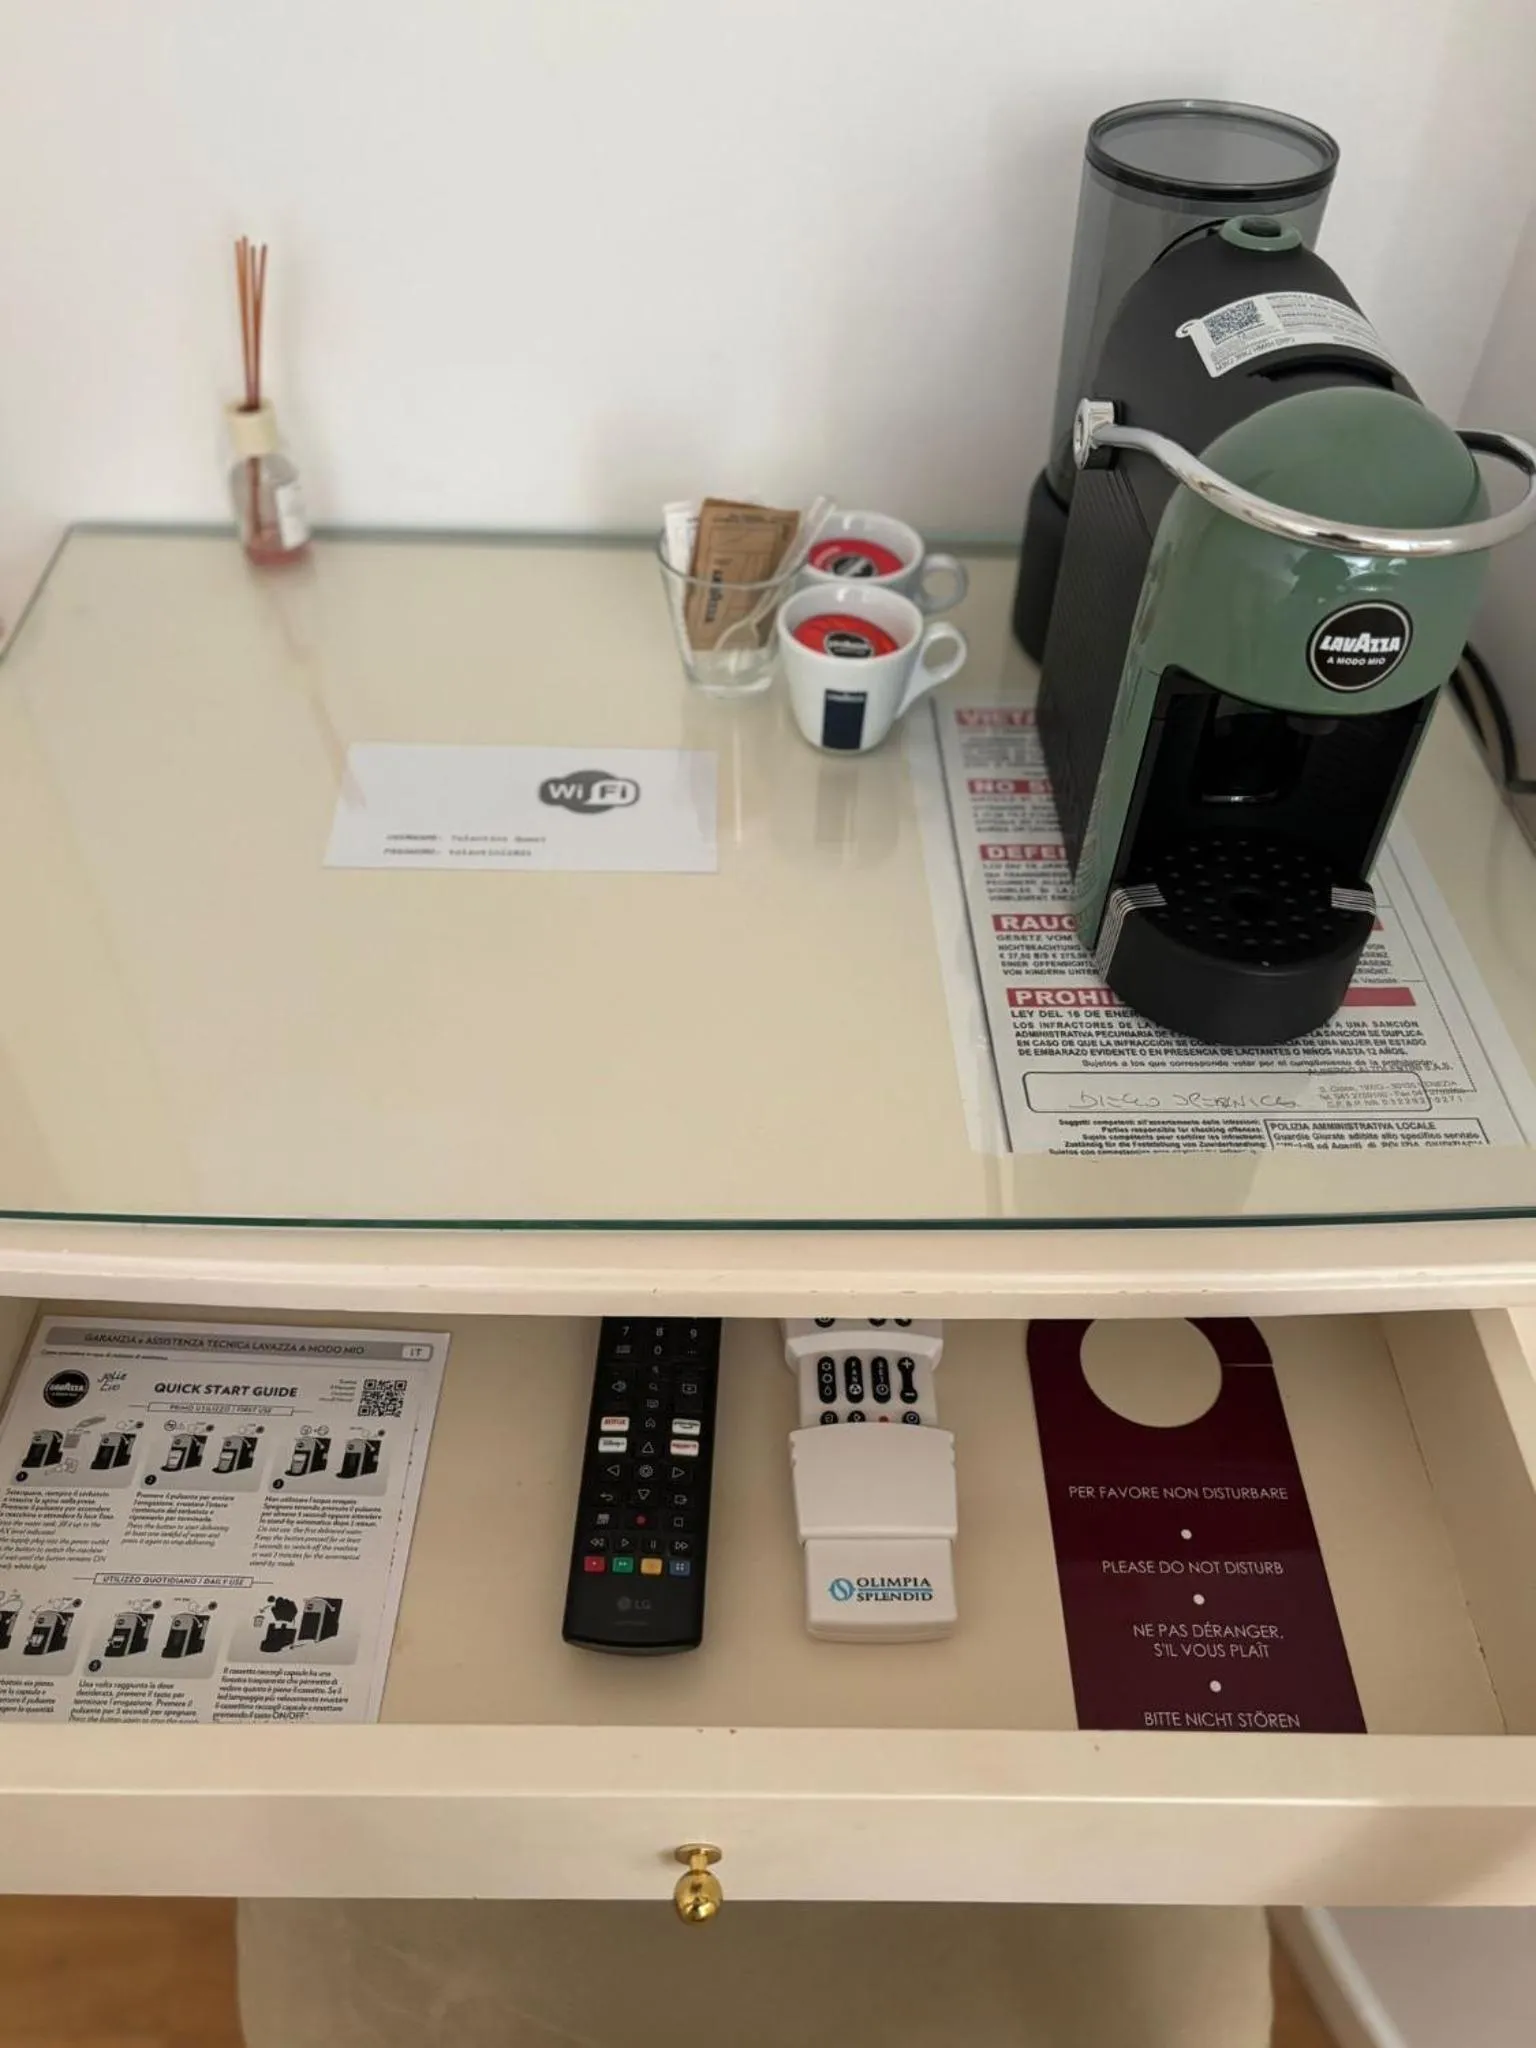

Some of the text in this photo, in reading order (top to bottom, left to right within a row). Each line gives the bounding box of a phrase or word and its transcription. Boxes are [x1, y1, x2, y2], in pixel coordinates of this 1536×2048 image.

[1319, 632, 1400, 653] LAVAZZA
[1326, 657, 1386, 666] A MODO MIO
[1010, 1009, 1034, 1018] LEY
[1039, 1009, 1063, 1018] DEL
[1084, 1009, 1101, 1018] DE
[1013, 1021, 1034, 1029] LOS
[1039, 1021, 1114, 1029] INFRACTORES
[1118, 1021, 1133, 1029] DE
[1015, 1030, 1094, 1038] ADMINISTRATIVA
[1017, 1039, 1030, 1047] EN
[1032, 1039, 1059, 1047] CASO
[1062, 1039, 1075, 1047] DE
[1078, 1039, 1098, 1047] QUE
[1018, 1048, 1032, 1056] DE
[1034, 1048, 1088, 1056] EMBARAZO
[1090, 1048, 1137, 1056] EVIDENTE
[1270, 1121, 1437, 1131] POLIZIA AMMINISTRATIVA LOCALE
[622, 1326, 698, 1339] 7 8 9
[84, 1333, 137, 1344] GARANZIA
[145, 1335, 204, 1348] ASSISTENZA
[207, 1339, 251, 1350] TECNICA
[252, 1341, 298, 1352] LAVAZZA
[308, 1344, 342, 1355] MODO
[343, 1346, 365, 1355] MIO
[154, 1381, 299, 1398] QUICK START GUIDE
[1068, 1486, 1289, 1501] PER FAVORE NON DISTURBARE
[1101, 1560, 1285, 1575] PLEASE DO NOT DISTURB
[102, 1575, 141, 1584] UTILIZZO
[856, 1577, 931, 1588] OLIMPIA
[856, 1591, 933, 1602] SPLENDID
[1133, 1623, 1155, 1638] NE
[1158, 1623, 1189, 1638] PAS
[1153, 1641, 1270, 1659] S'IL VOUS PLAÎT
[1143, 1710, 1301, 1729] BITTE NICHT STÖREN
